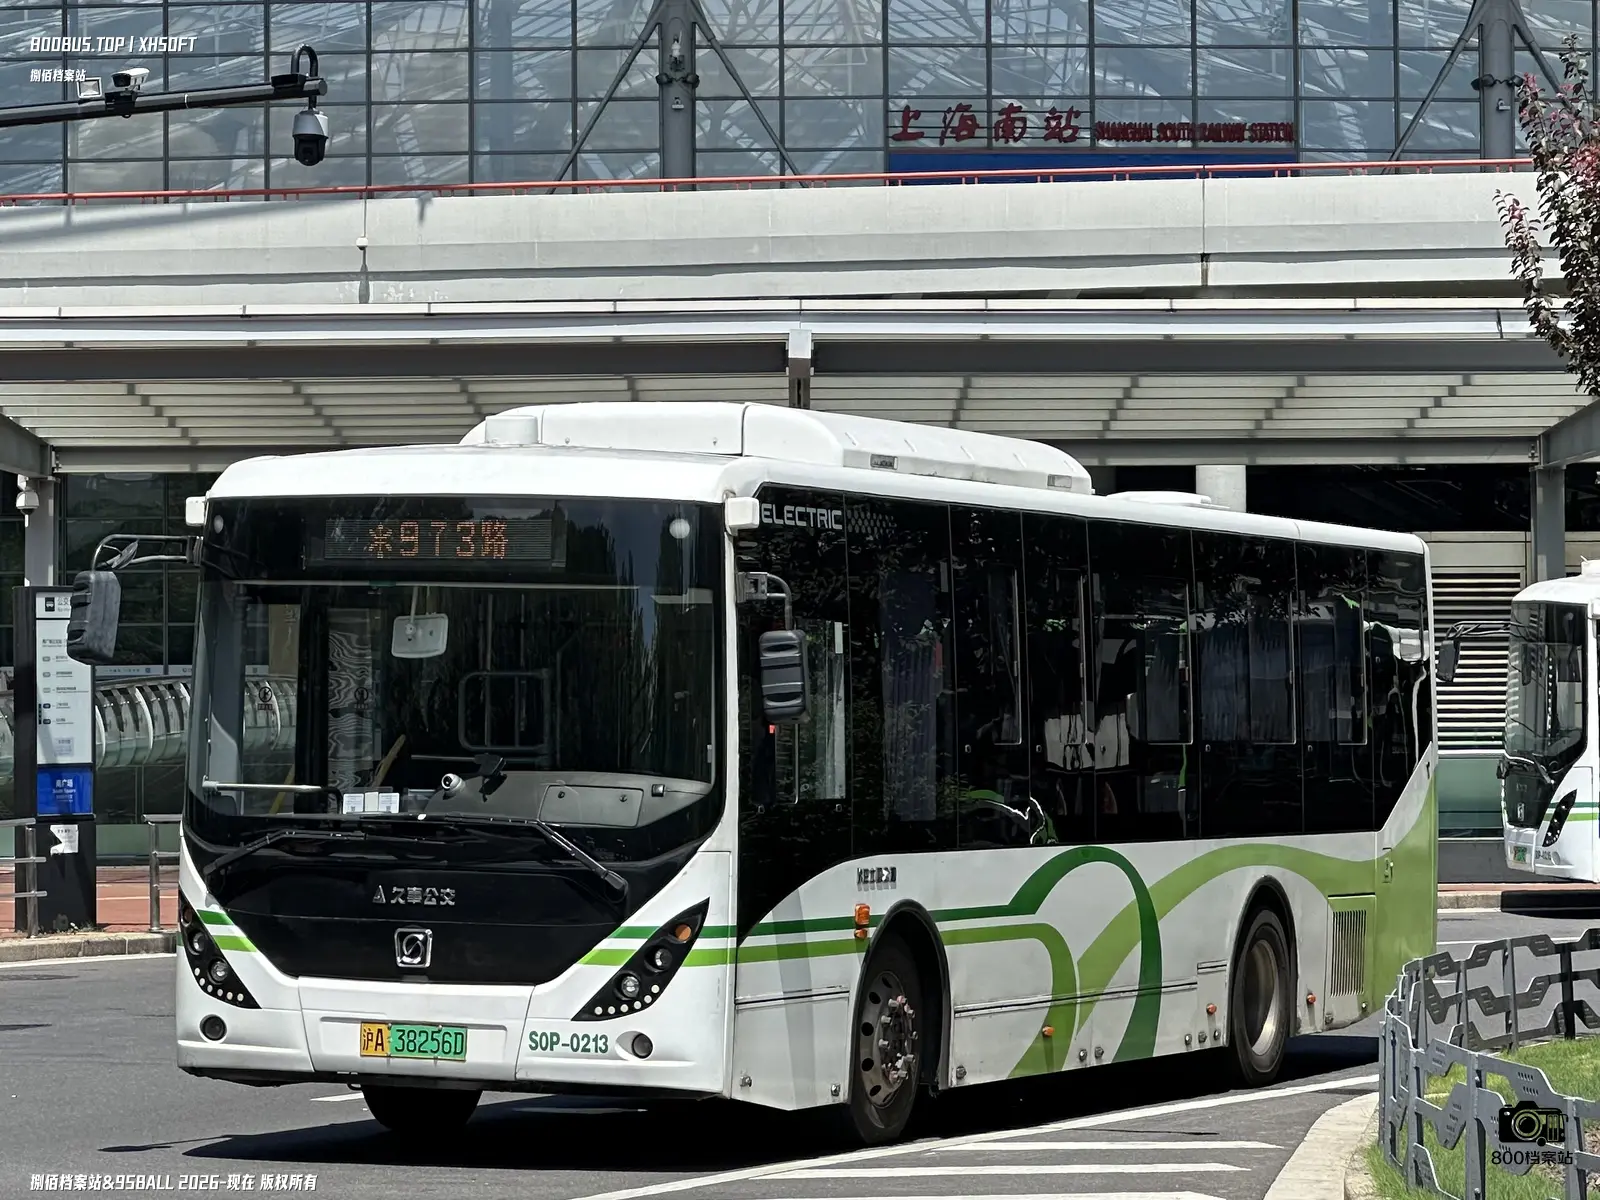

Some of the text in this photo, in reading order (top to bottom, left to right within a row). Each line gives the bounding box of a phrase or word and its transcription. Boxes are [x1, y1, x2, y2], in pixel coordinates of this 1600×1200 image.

[891, 103, 1081, 147] 上海南站
[1095, 121, 1154, 142] SHANGHAI
[1249, 122, 1295, 142] STATION
[761, 503, 843, 530] ELECTRIC
